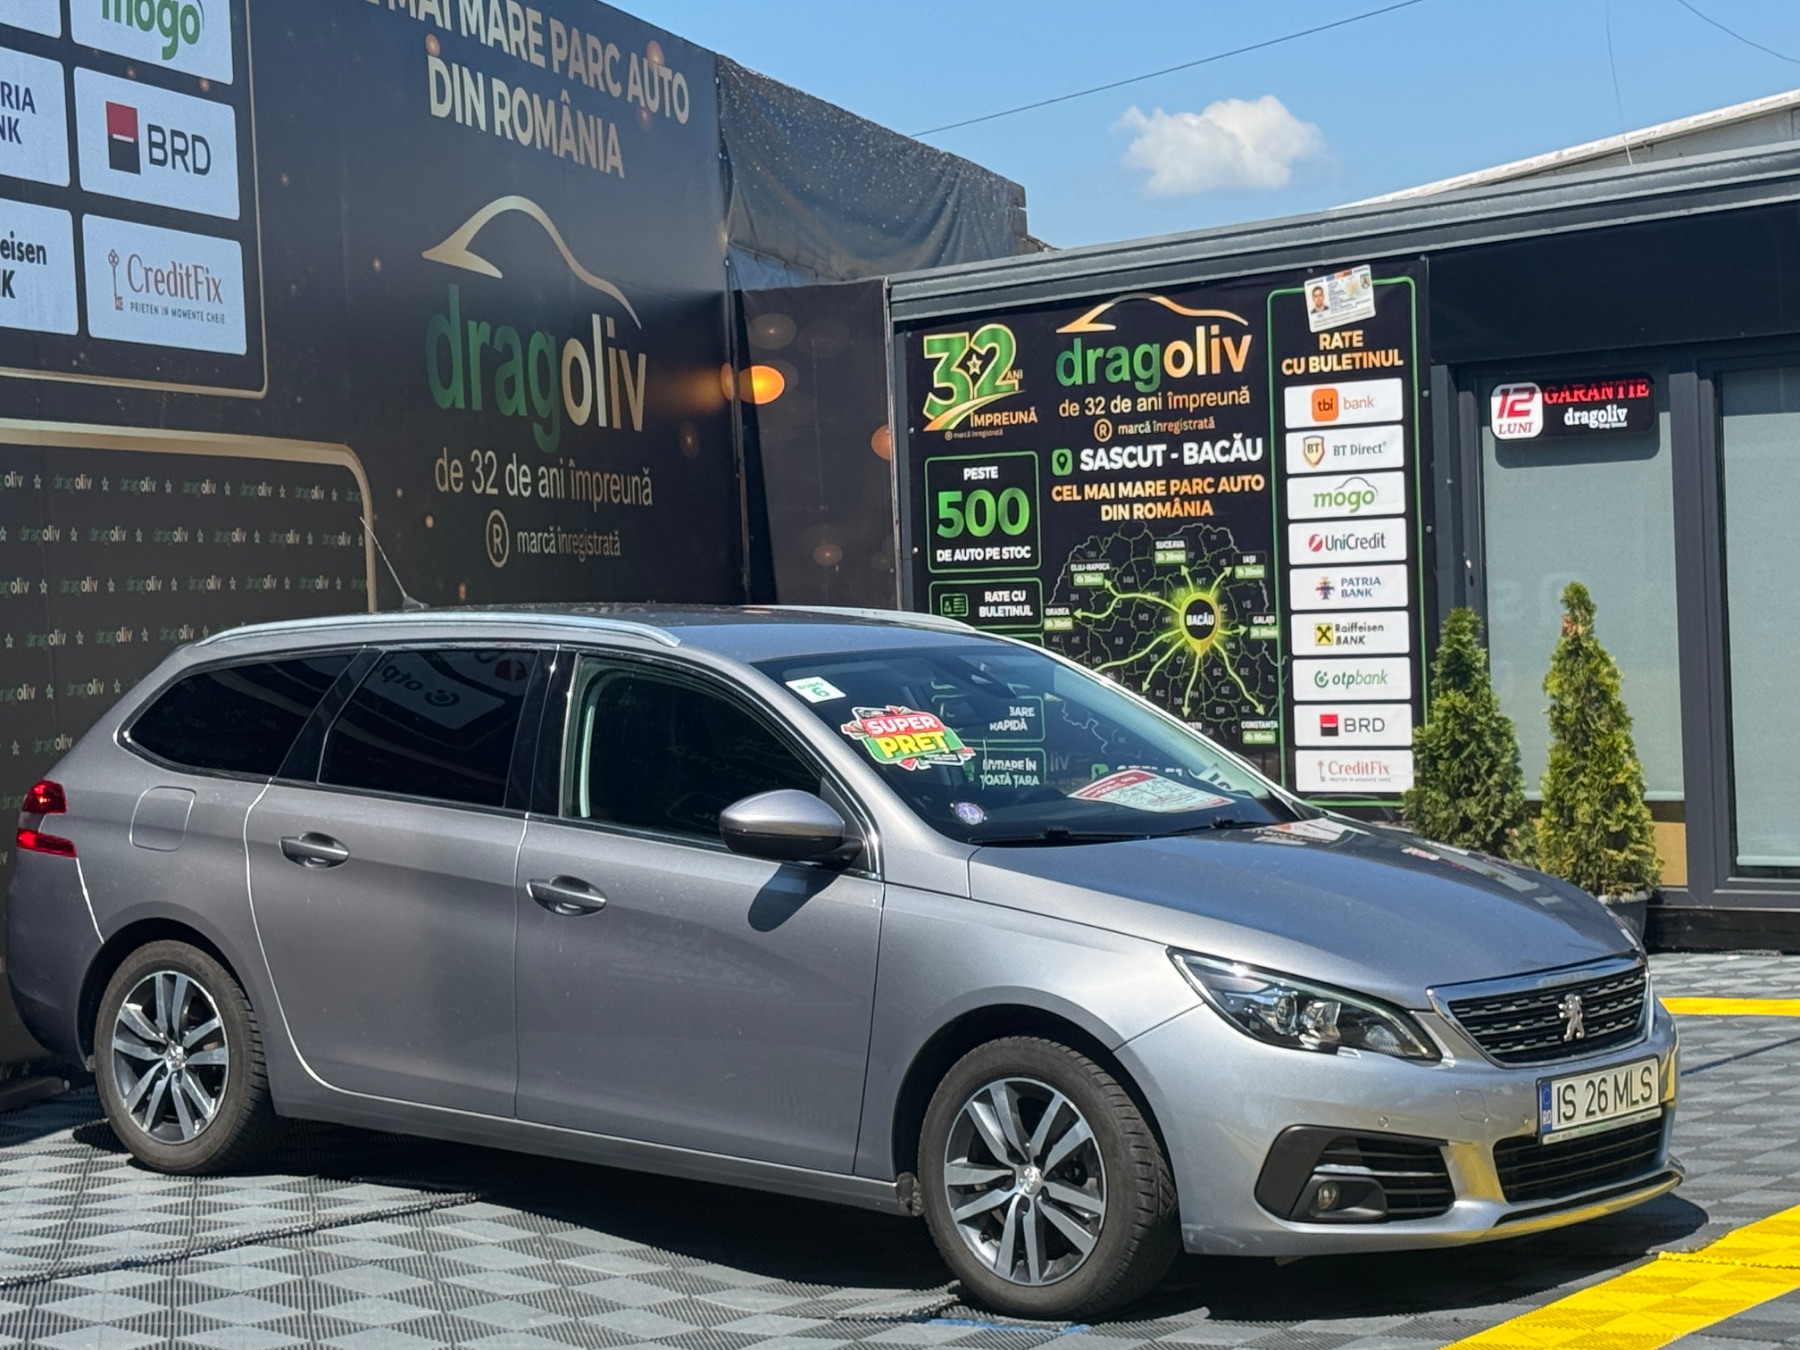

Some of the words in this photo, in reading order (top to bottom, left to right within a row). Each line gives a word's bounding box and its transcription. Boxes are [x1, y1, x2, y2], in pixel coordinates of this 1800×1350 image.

[459, 0, 546, 69] MARE
[549, 17, 622, 98] PARC
[627, 52, 690, 124] AUTO
[427, 55, 487, 132] DIN
[492, 77, 625, 178] ROMÂNIA
[147, 124, 211, 176] BRD
[128, 254, 223, 304] CreditFix
[130, 302, 159, 315] PRIETEN
[171, 308, 205, 322] MOMENTE
[206, 312, 225, 324] CHEIE
[1319, 330, 1364, 350] RATE
[426, 282, 647, 453] dragoliv
[1056, 325, 1252, 393] dragoliv
[1281, 357, 1306, 376] CU
[1308, 348, 1404, 374] BULETINUL
[923, 323, 1018, 421] 32
[1006, 369, 1023, 380] ANI
[1059, 399, 1080, 417] de
[1084, 397, 1105, 415] 32
[1111, 394, 1130, 414] de
[1137, 392, 1162, 412] ani
[1167, 385, 1250, 414] împreună
[1497, 386, 1536, 419] 12
[1544, 379, 1650, 405] GARANTIE
[1317, 398, 1333, 412] tbi
[1344, 395, 1375, 410] bank
[970, 406, 1038, 427] ÎMPREUNĂ
[1118, 419, 1150, 436] marcă
[1152, 416, 1215, 436] înregistrată
[1564, 404, 1628, 428] dragoliv
[1498, 422, 1533, 435] LUNI
[1080, 444, 1167, 471] SASCUT
[1183, 433, 1263, 466] BACĂU
[1307, 443, 1319, 454] BT
[1333, 445, 1347, 456] BT
[434, 447, 463, 493] de
[471, 449, 498, 495] 32
[505, 452, 531, 497] de
[538, 457, 564, 500] ani
[570, 458, 653, 513] împreună
[963, 466, 998, 480] PESTE
[1052, 485, 1081, 501] CEL
[1084, 482, 1115, 500] MAI
[1118, 480, 1166, 498] MARE
[1170, 477, 1216, 496] PARC
[1217, 474, 1265, 492] AUTO
[1101, 504, 1130, 521] DIN
[1133, 497, 1213, 520] ROMÂNIA
[1313, 489, 1375, 514] mogo
[937, 487, 1030, 538] 500
[517, 527, 557, 555] marcă
[558, 527, 621, 563] înregistrată
[1325, 532, 1386, 551] UniCredit
[936, 549, 952, 562] DE
[954, 548, 984, 561] AUTO
[985, 547, 1000, 560] PE
[1002, 546, 1031, 559] STOC
[1341, 577, 1381, 588] PATRIA
[1341, 588, 1373, 598] BANK
[985, 591, 1010, 602] RATE
[1011, 590, 1026, 601] CU
[979, 605, 1033, 617] BULETINUL
[1186, 612, 1215, 627] BACĂU
[1335, 622, 1384, 633] Raiffeisen
[1336, 635, 1366, 646] BANK
[1332, 669, 1388, 690] otpbank
[866, 716, 937, 735] SUPER
[1345, 718, 1385, 733] BRD
[875, 731, 949, 758] PREȚ
[1026, 758, 1037, 771] ÎN
[1328, 760, 1390, 776] CreditFix
[1557, 1083, 1576, 1124] IS
[1585, 1077, 1608, 1118] 26
[1614, 1066, 1652, 1112] MLS
